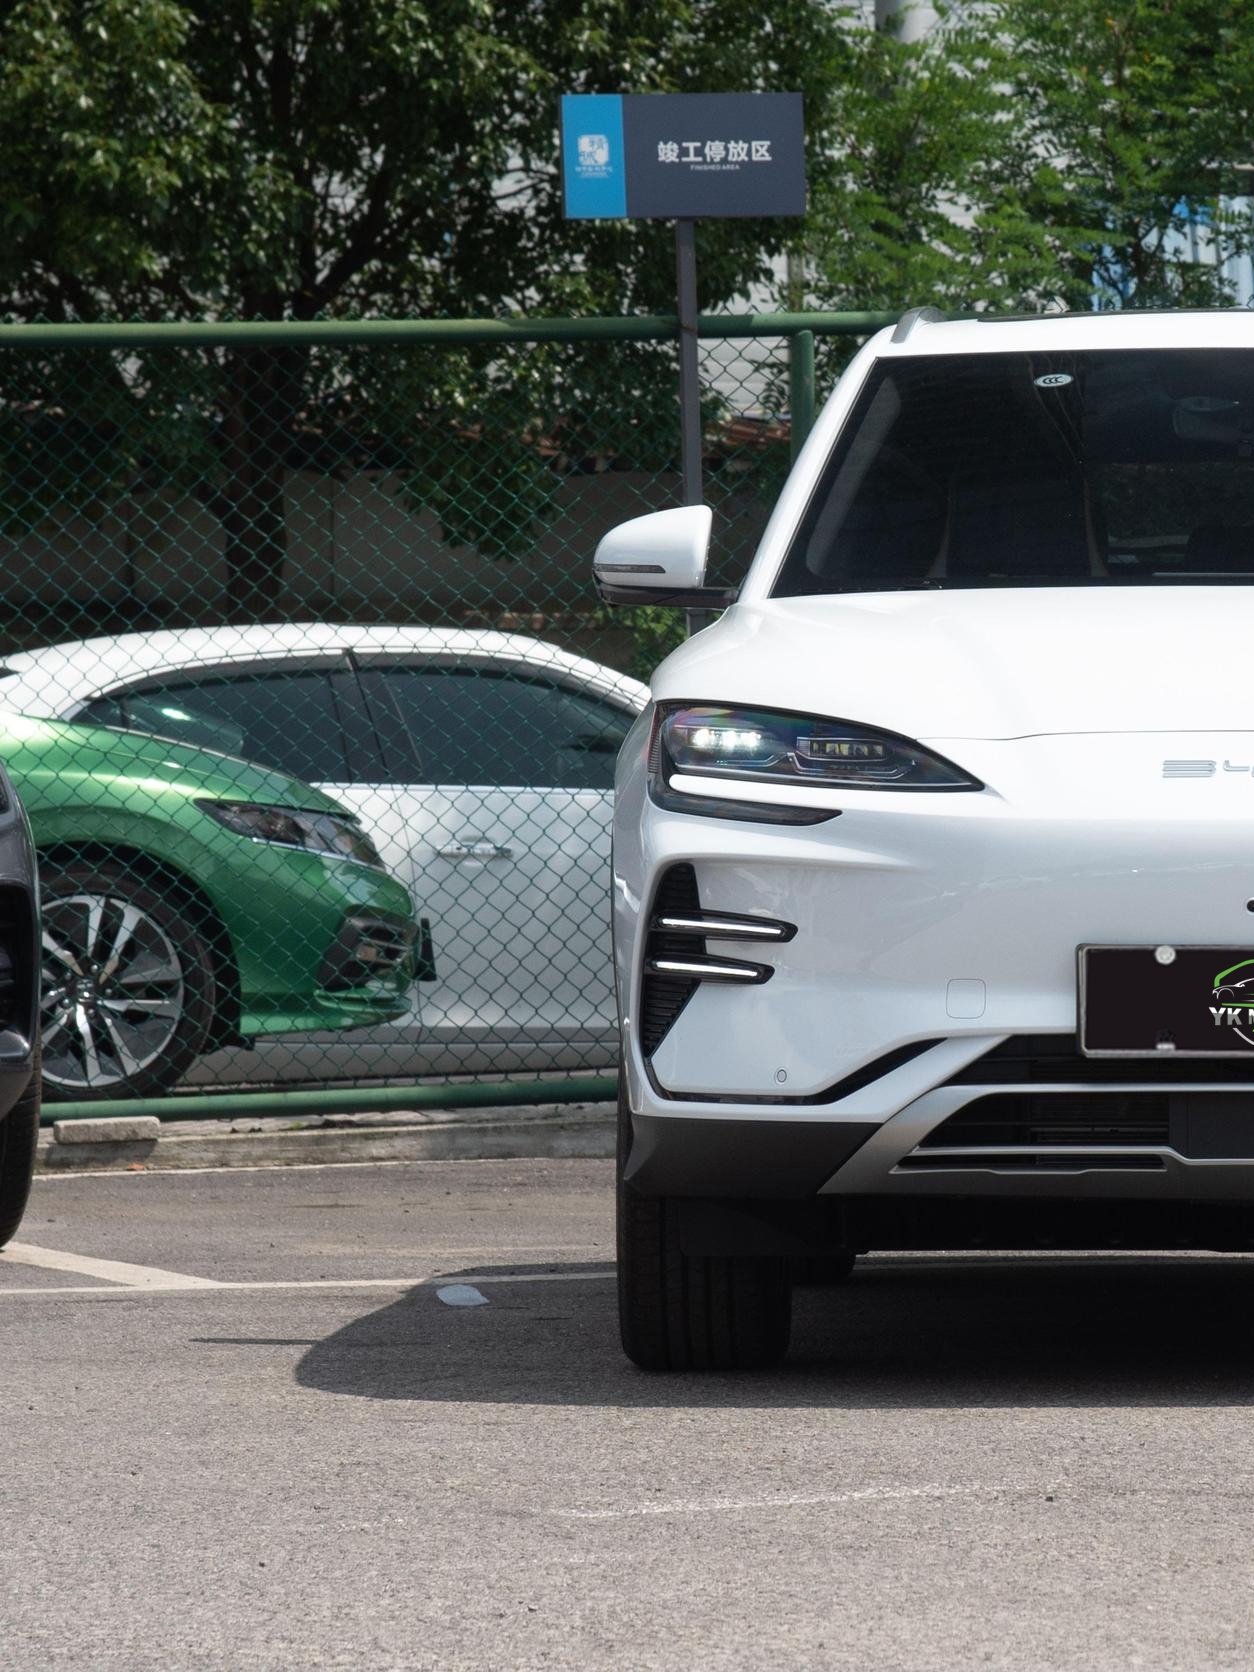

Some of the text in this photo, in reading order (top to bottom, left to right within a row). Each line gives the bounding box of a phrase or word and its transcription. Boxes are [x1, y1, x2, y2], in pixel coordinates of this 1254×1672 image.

[657, 140, 772, 162] 竣工停放区
[1208, 1006, 1243, 1026] YK
